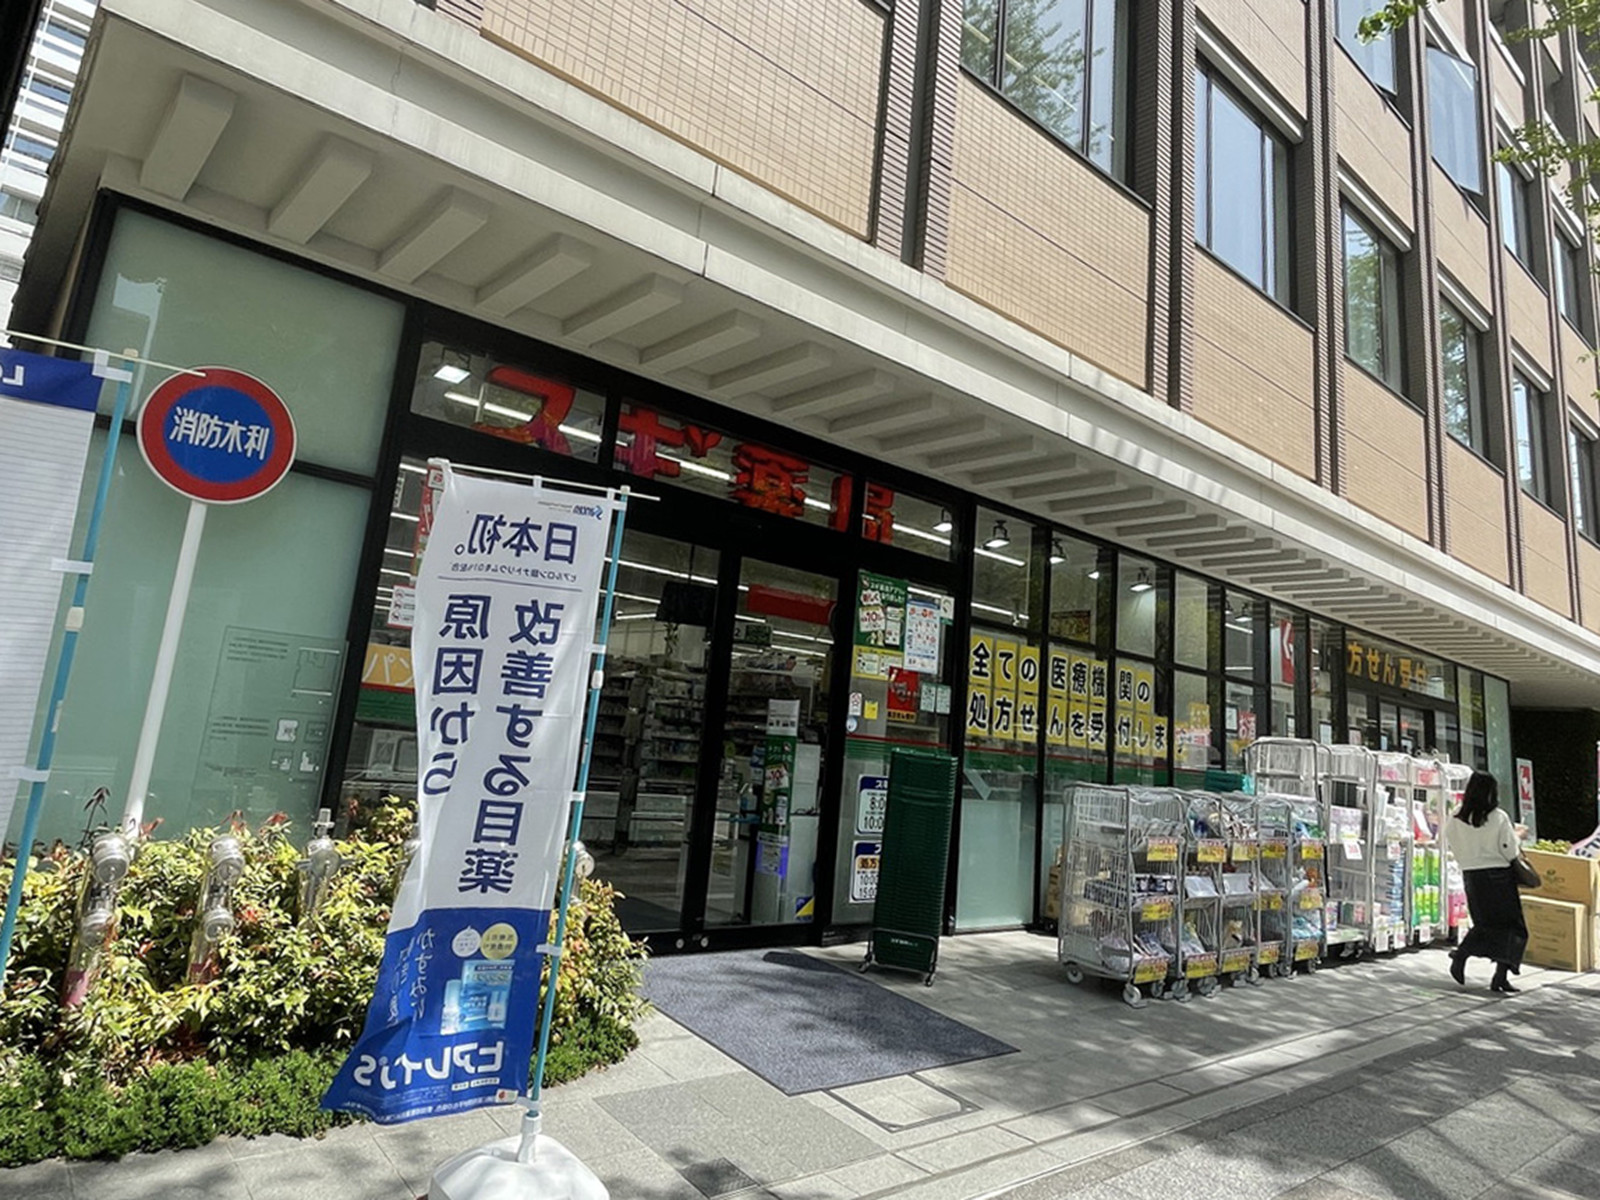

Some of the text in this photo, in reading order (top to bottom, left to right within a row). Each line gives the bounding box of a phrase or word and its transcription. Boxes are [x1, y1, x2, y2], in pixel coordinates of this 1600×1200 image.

[168, 406, 272, 460] 消防水利
[970, 641, 1151, 702] 全ての医療機関の
